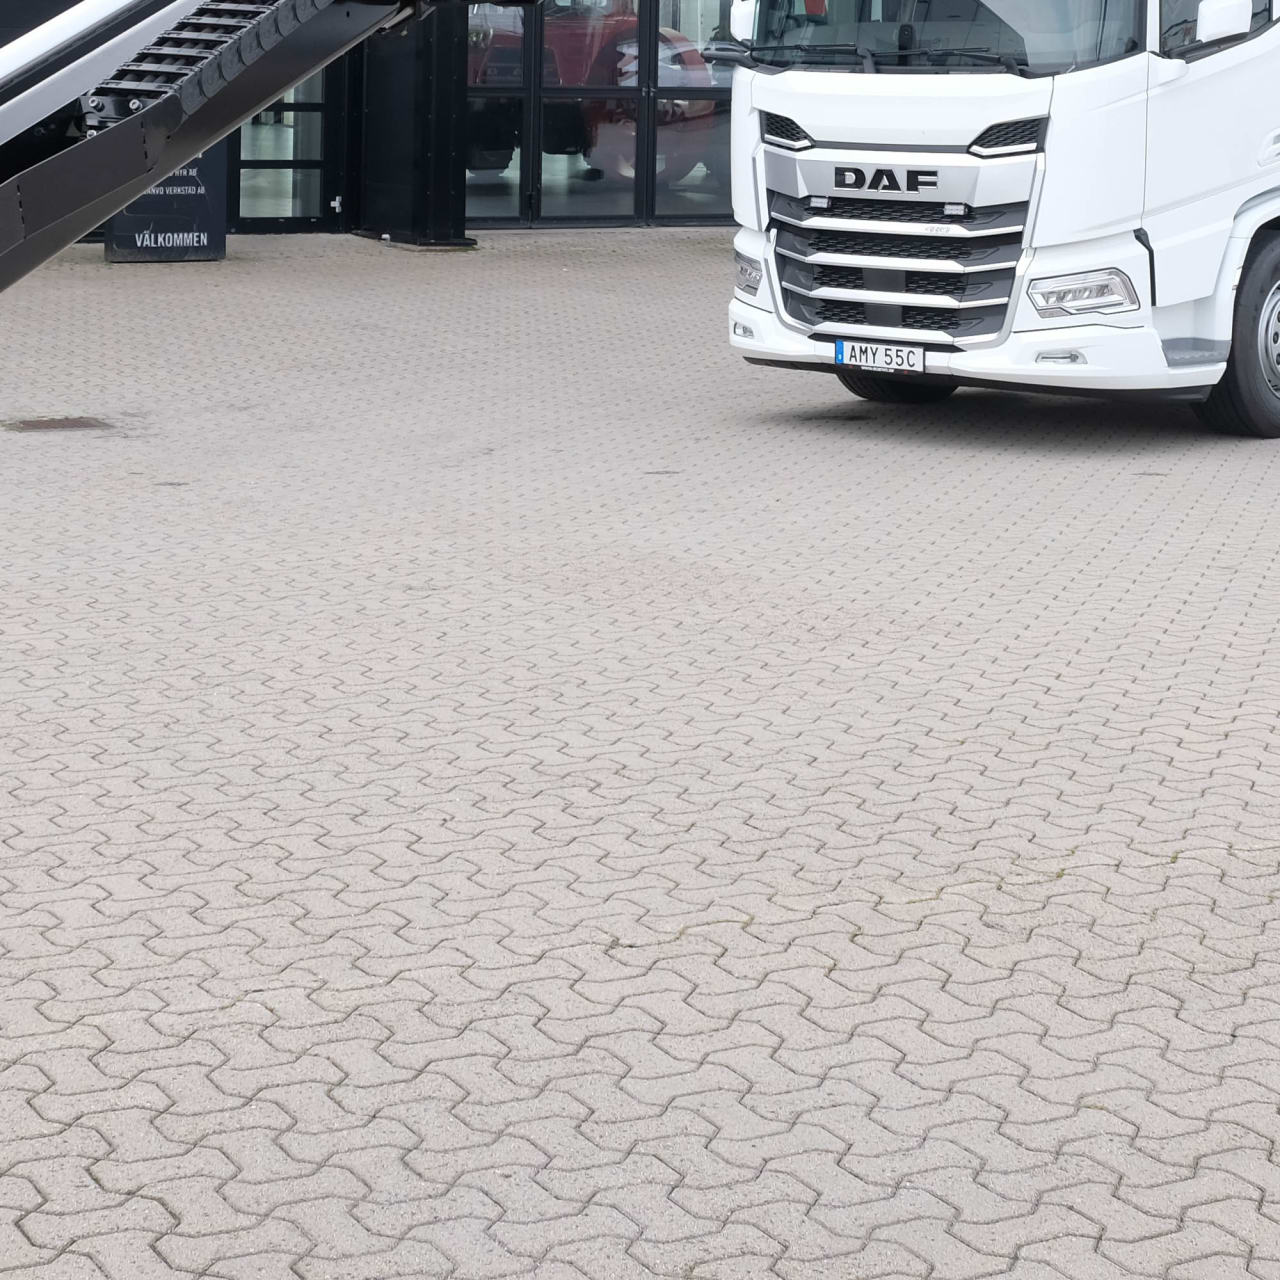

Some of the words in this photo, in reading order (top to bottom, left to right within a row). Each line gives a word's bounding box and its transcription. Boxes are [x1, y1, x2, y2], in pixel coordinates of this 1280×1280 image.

[833, 166, 938, 193] DAF
[135, 230, 208, 248] VÄLKOMMEN
[849, 344, 878, 364] AMY
[884, 348, 916, 368] 55C
